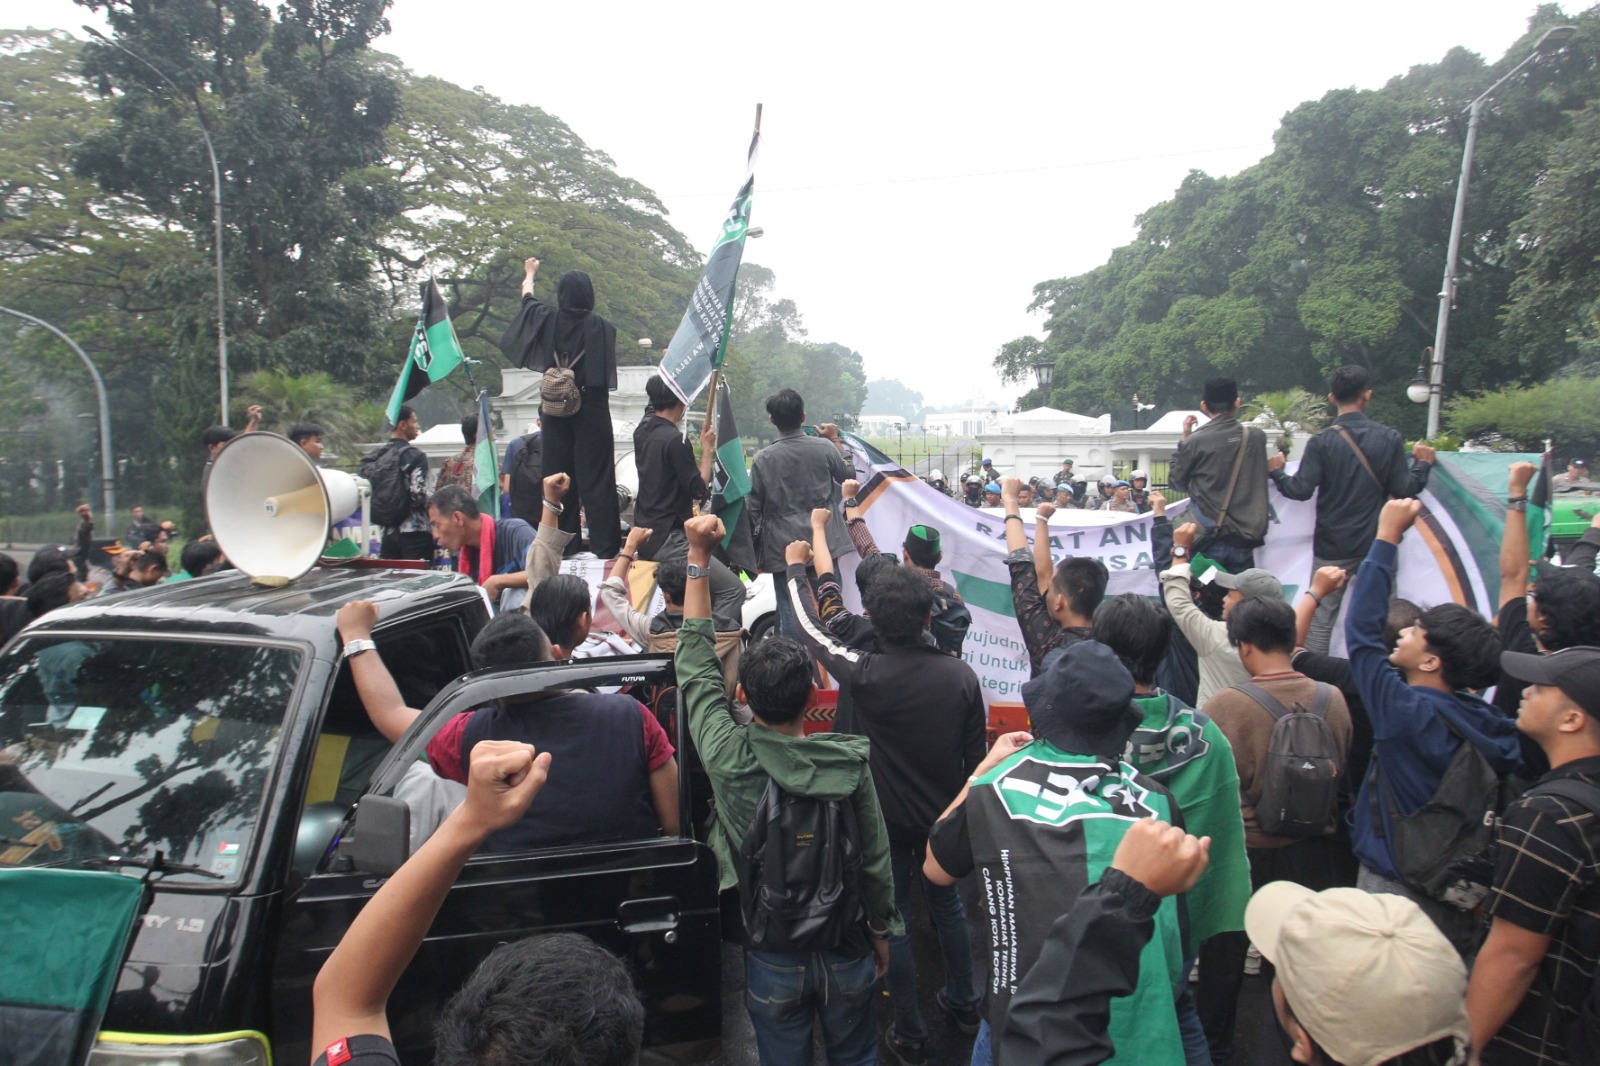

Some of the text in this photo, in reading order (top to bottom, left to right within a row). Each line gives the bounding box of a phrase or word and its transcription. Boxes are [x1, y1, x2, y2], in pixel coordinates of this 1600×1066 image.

[700, 313, 713, 333] KOTA
[980, 653, 1028, 673] Untuk
[982, 867, 997, 916] CABANG
[990, 918, 999, 948] KOTA
[996, 880, 1008, 989] KOMISARIAT TEKNIK
[1001, 849, 1014, 909] HIMPUNAN
[1009, 912, 1018, 982] MAHASISWA
